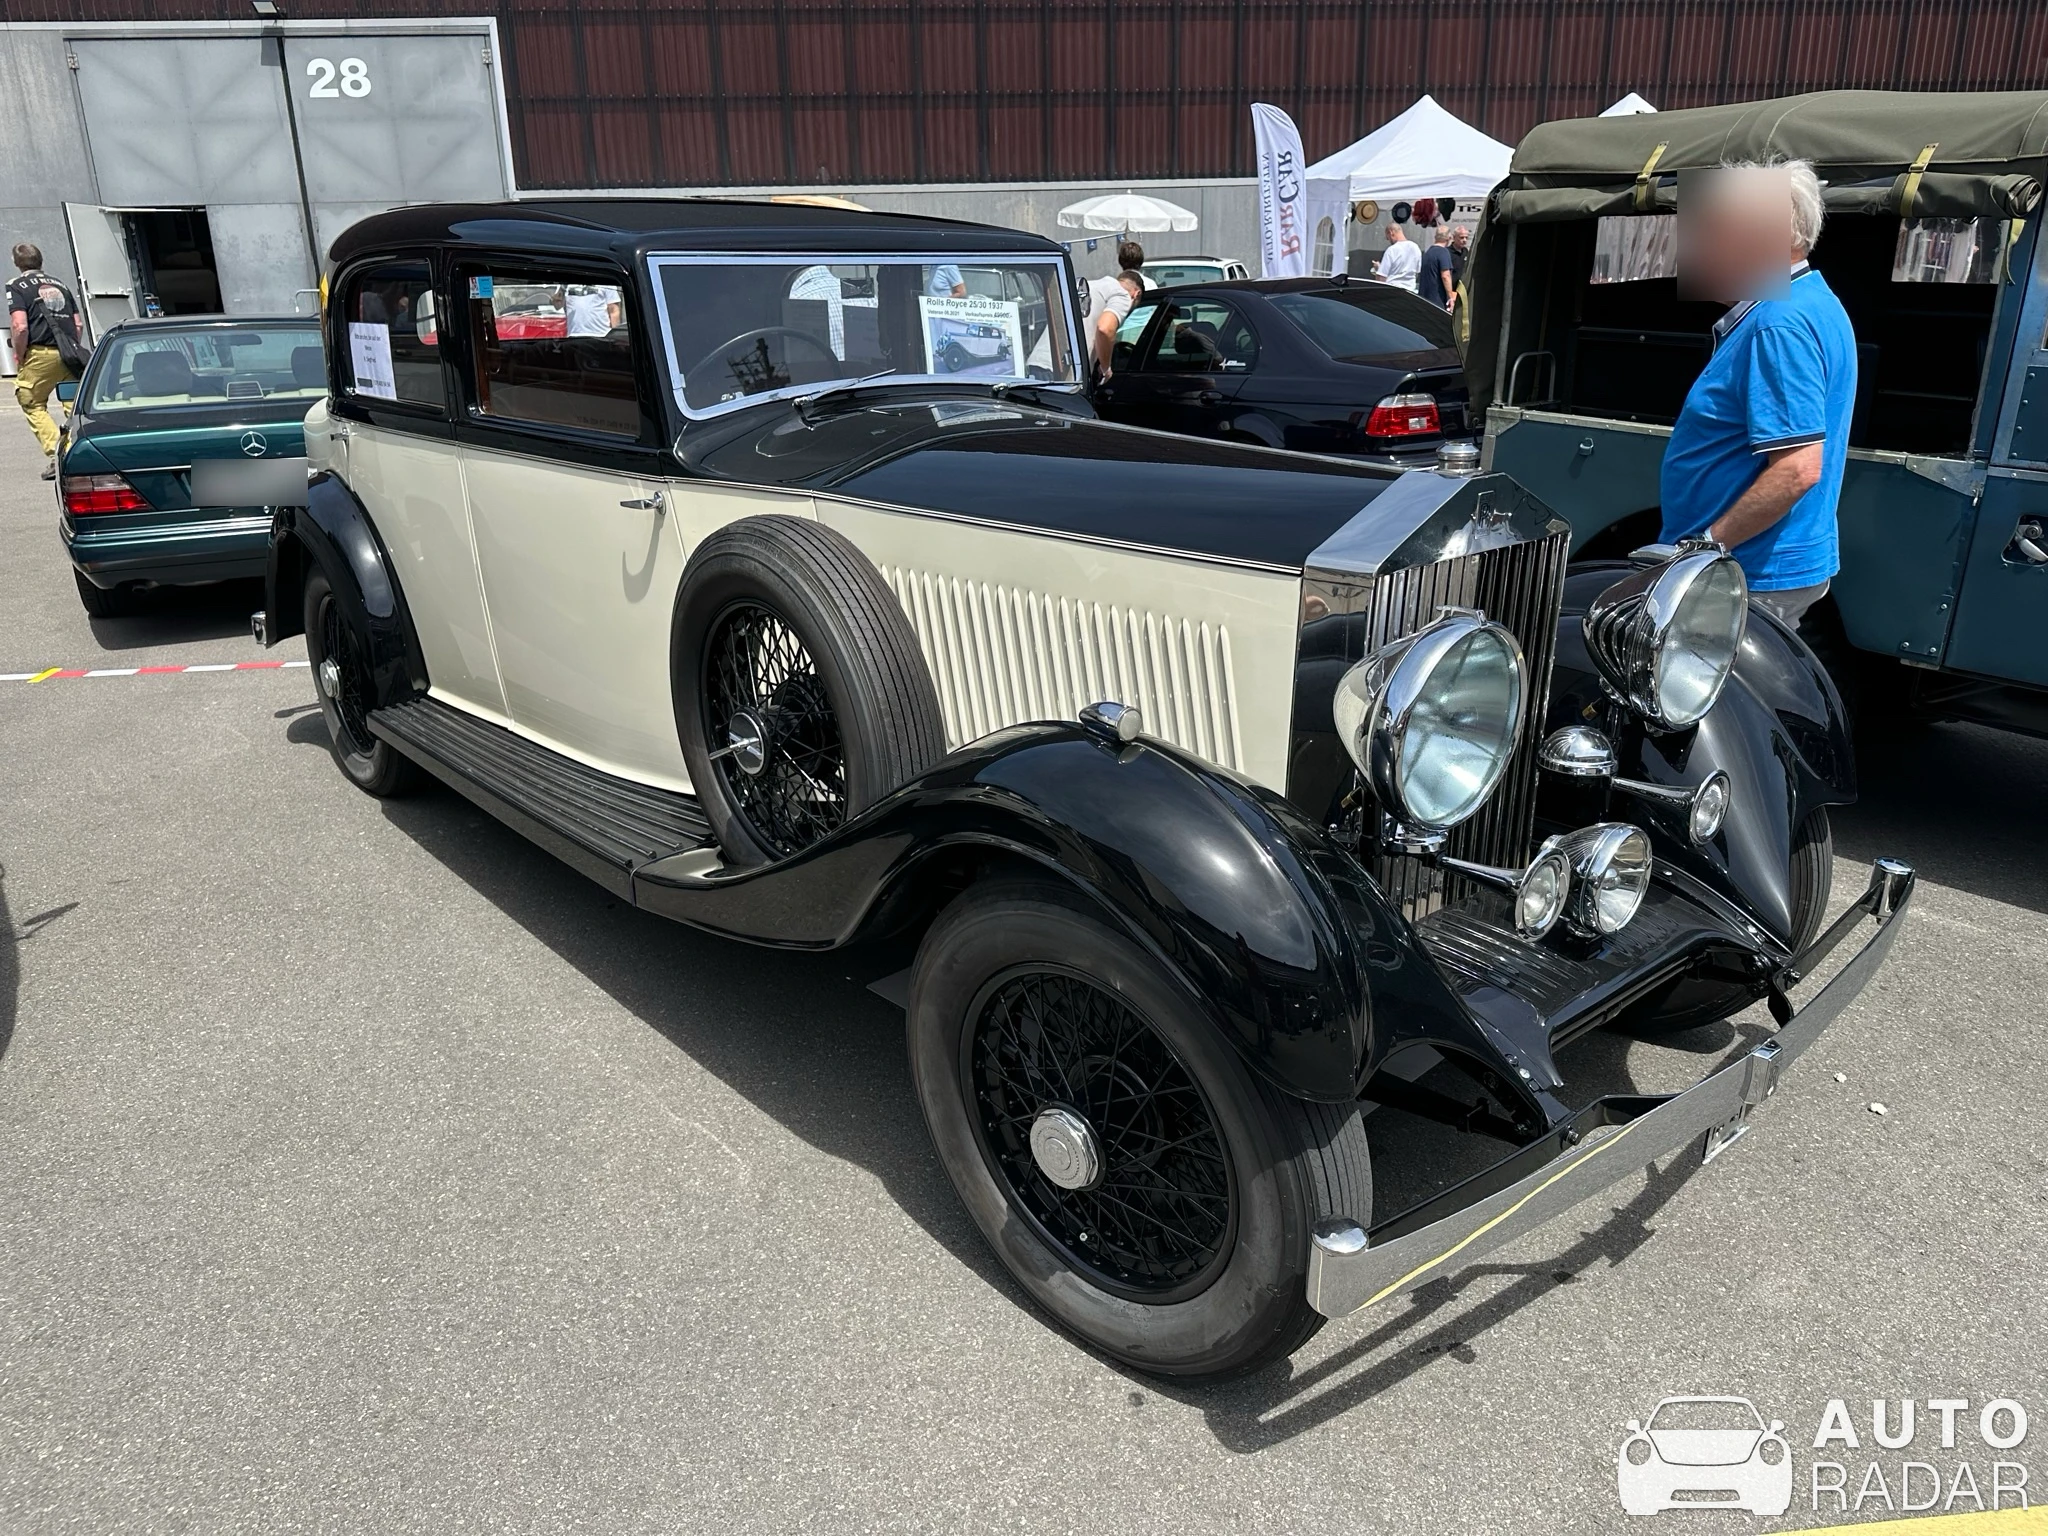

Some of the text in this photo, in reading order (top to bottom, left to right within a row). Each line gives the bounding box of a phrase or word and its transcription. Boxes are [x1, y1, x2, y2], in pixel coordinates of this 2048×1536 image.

[306, 57, 372, 98] 28
[926, 297, 1004, 310] Rolls Royce 25/30 1937
